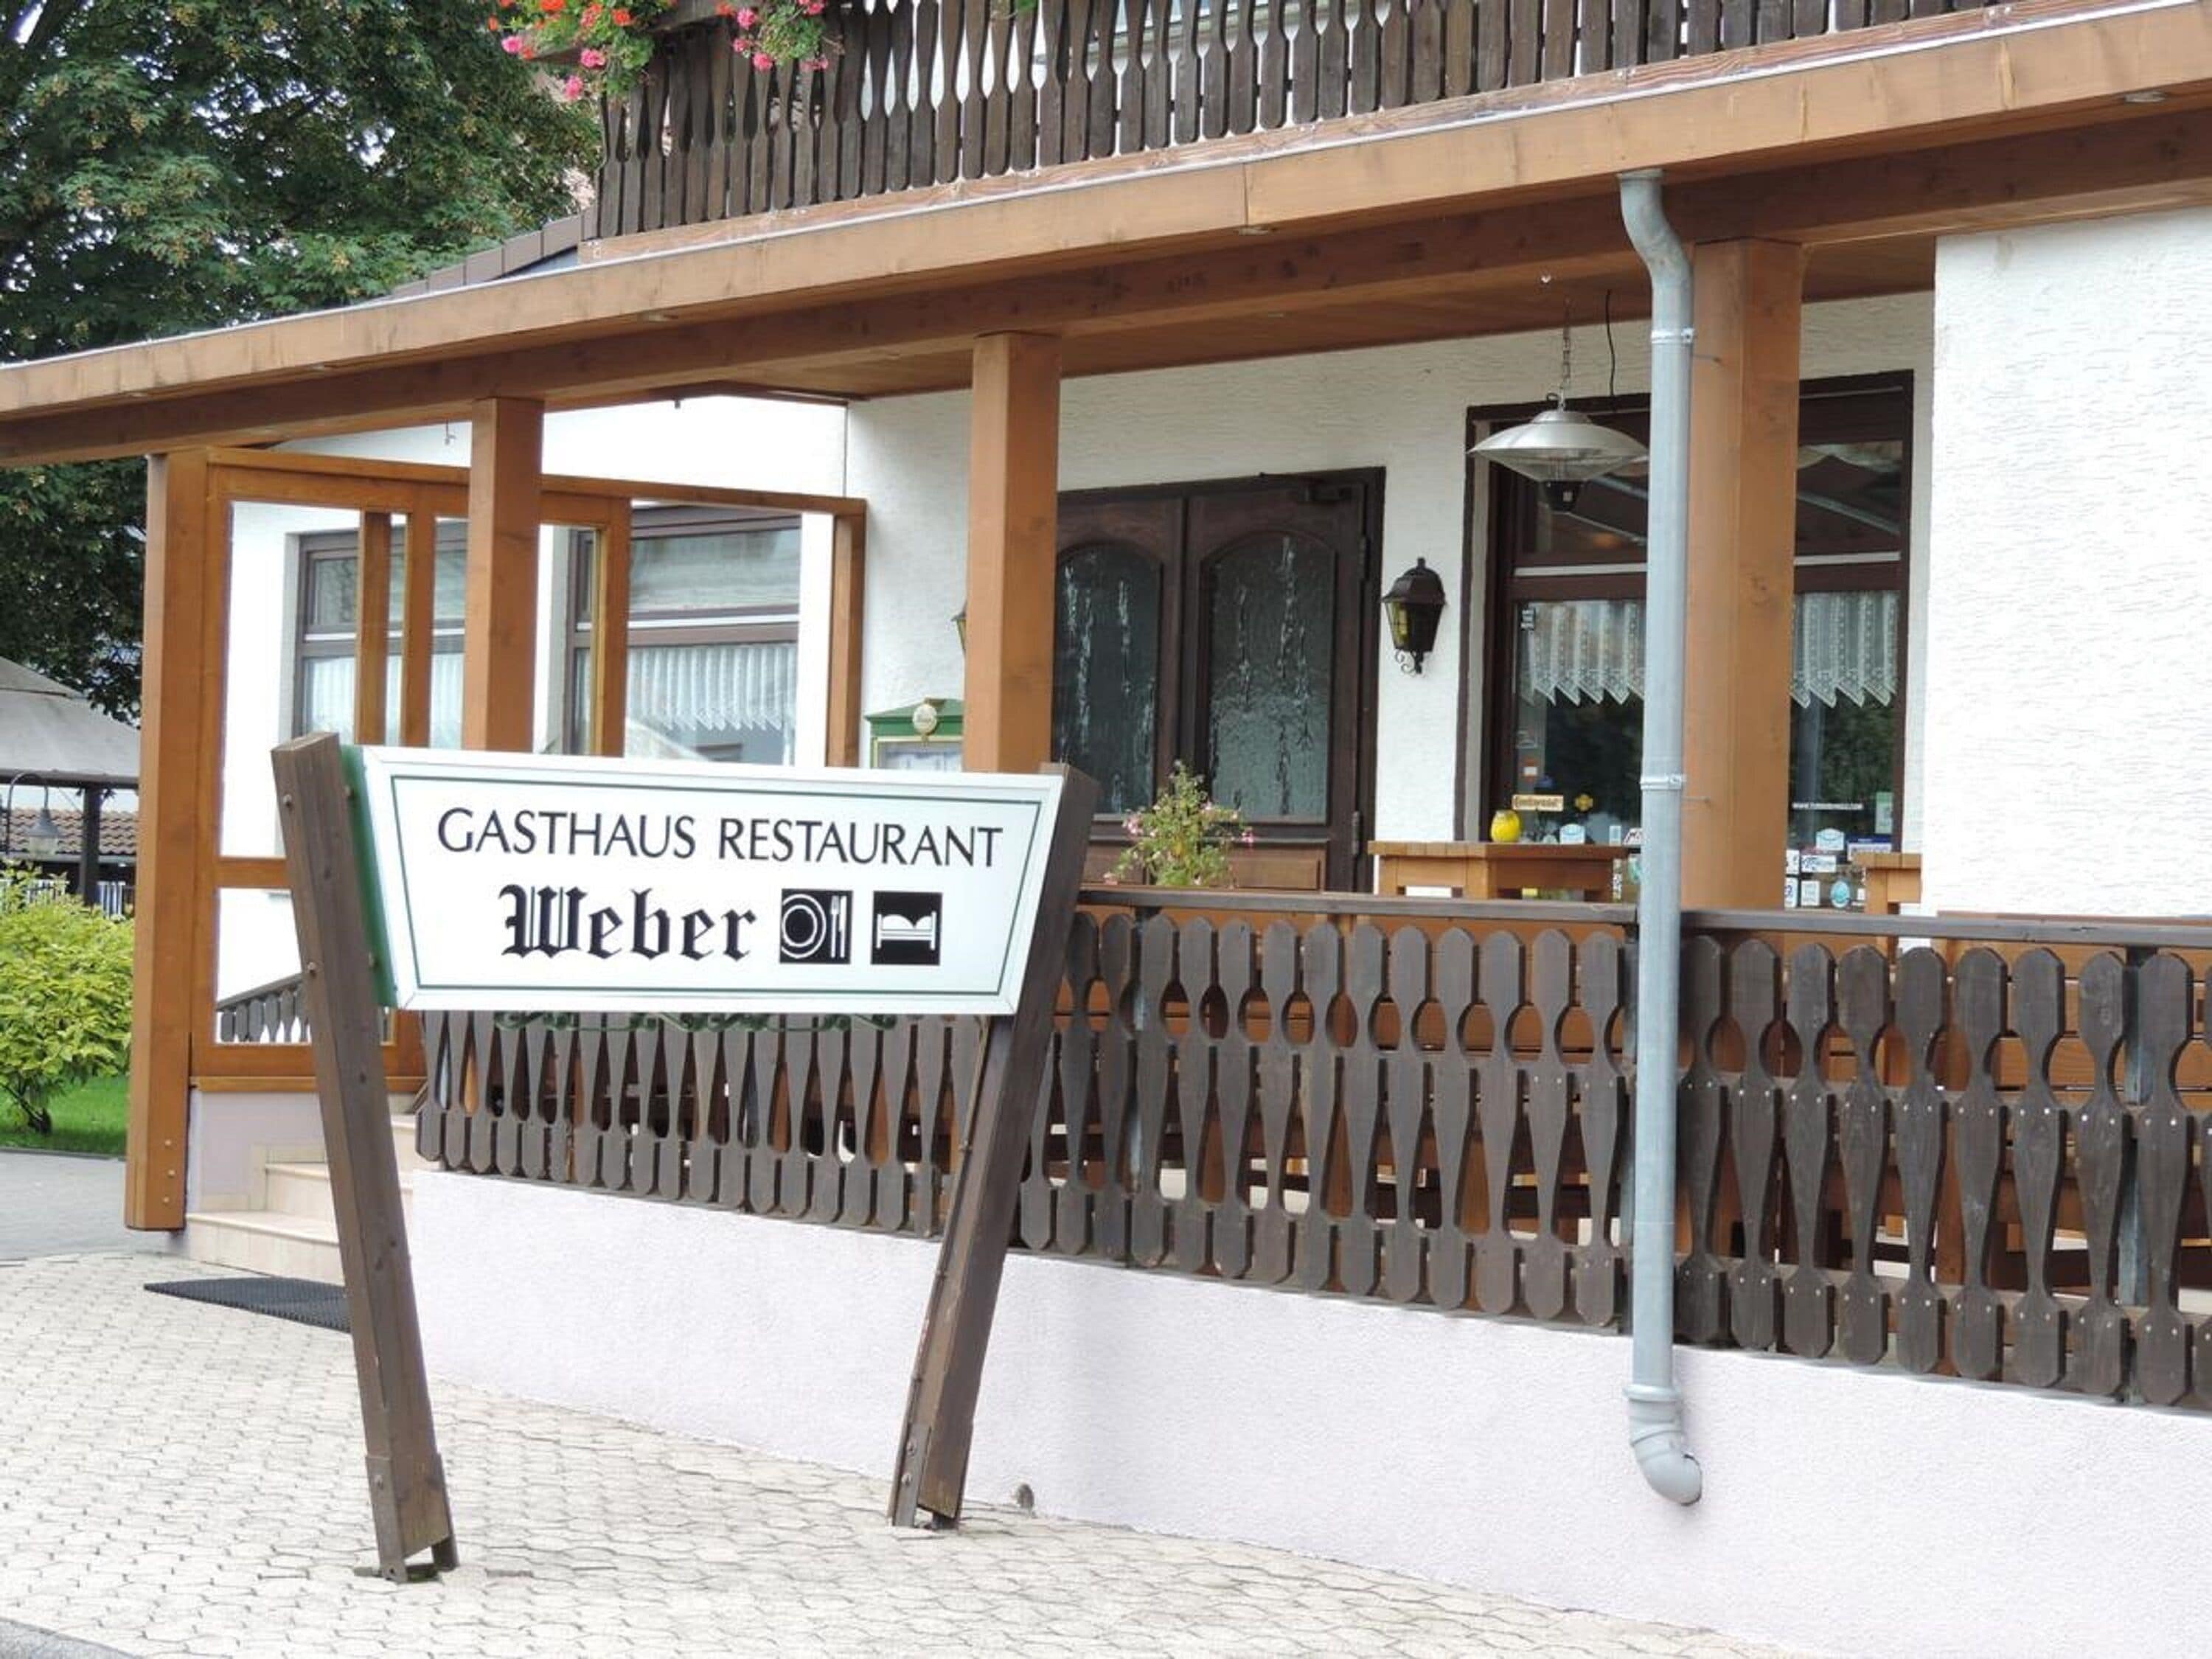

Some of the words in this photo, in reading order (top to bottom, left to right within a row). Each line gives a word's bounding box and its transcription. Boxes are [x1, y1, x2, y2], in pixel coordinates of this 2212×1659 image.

[438, 807, 695, 859] GASTHAUS
[719, 818, 1004, 867] RESTAURANT
[499, 884, 756, 961] Weber
